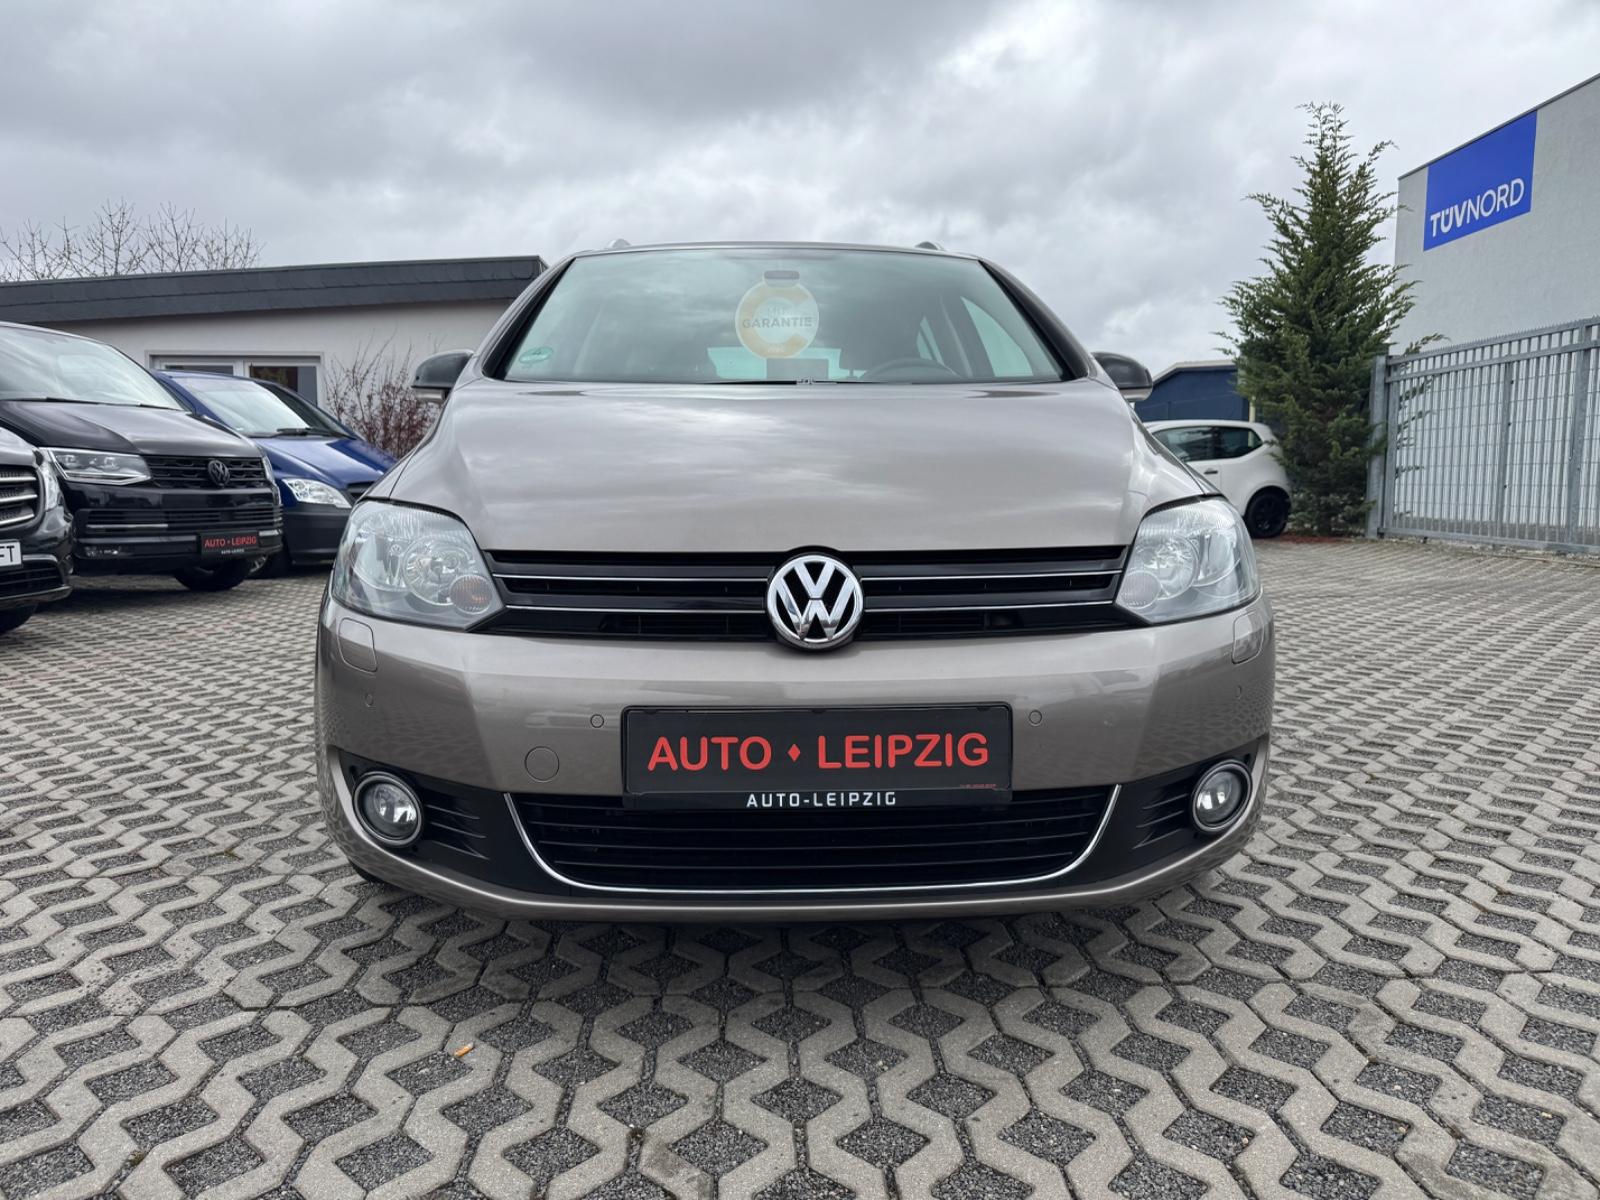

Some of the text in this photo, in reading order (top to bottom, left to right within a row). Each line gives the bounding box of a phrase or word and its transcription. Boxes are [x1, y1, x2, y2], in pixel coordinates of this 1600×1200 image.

[742, 316, 813, 328] GARANTIE
[204, 538, 226, 548] AUTO
[767, 555, 863, 649] VW
[647, 732, 988, 771] AUTO LEIPZIG
[746, 791, 896, 808] AUTO-LEIPZIG
